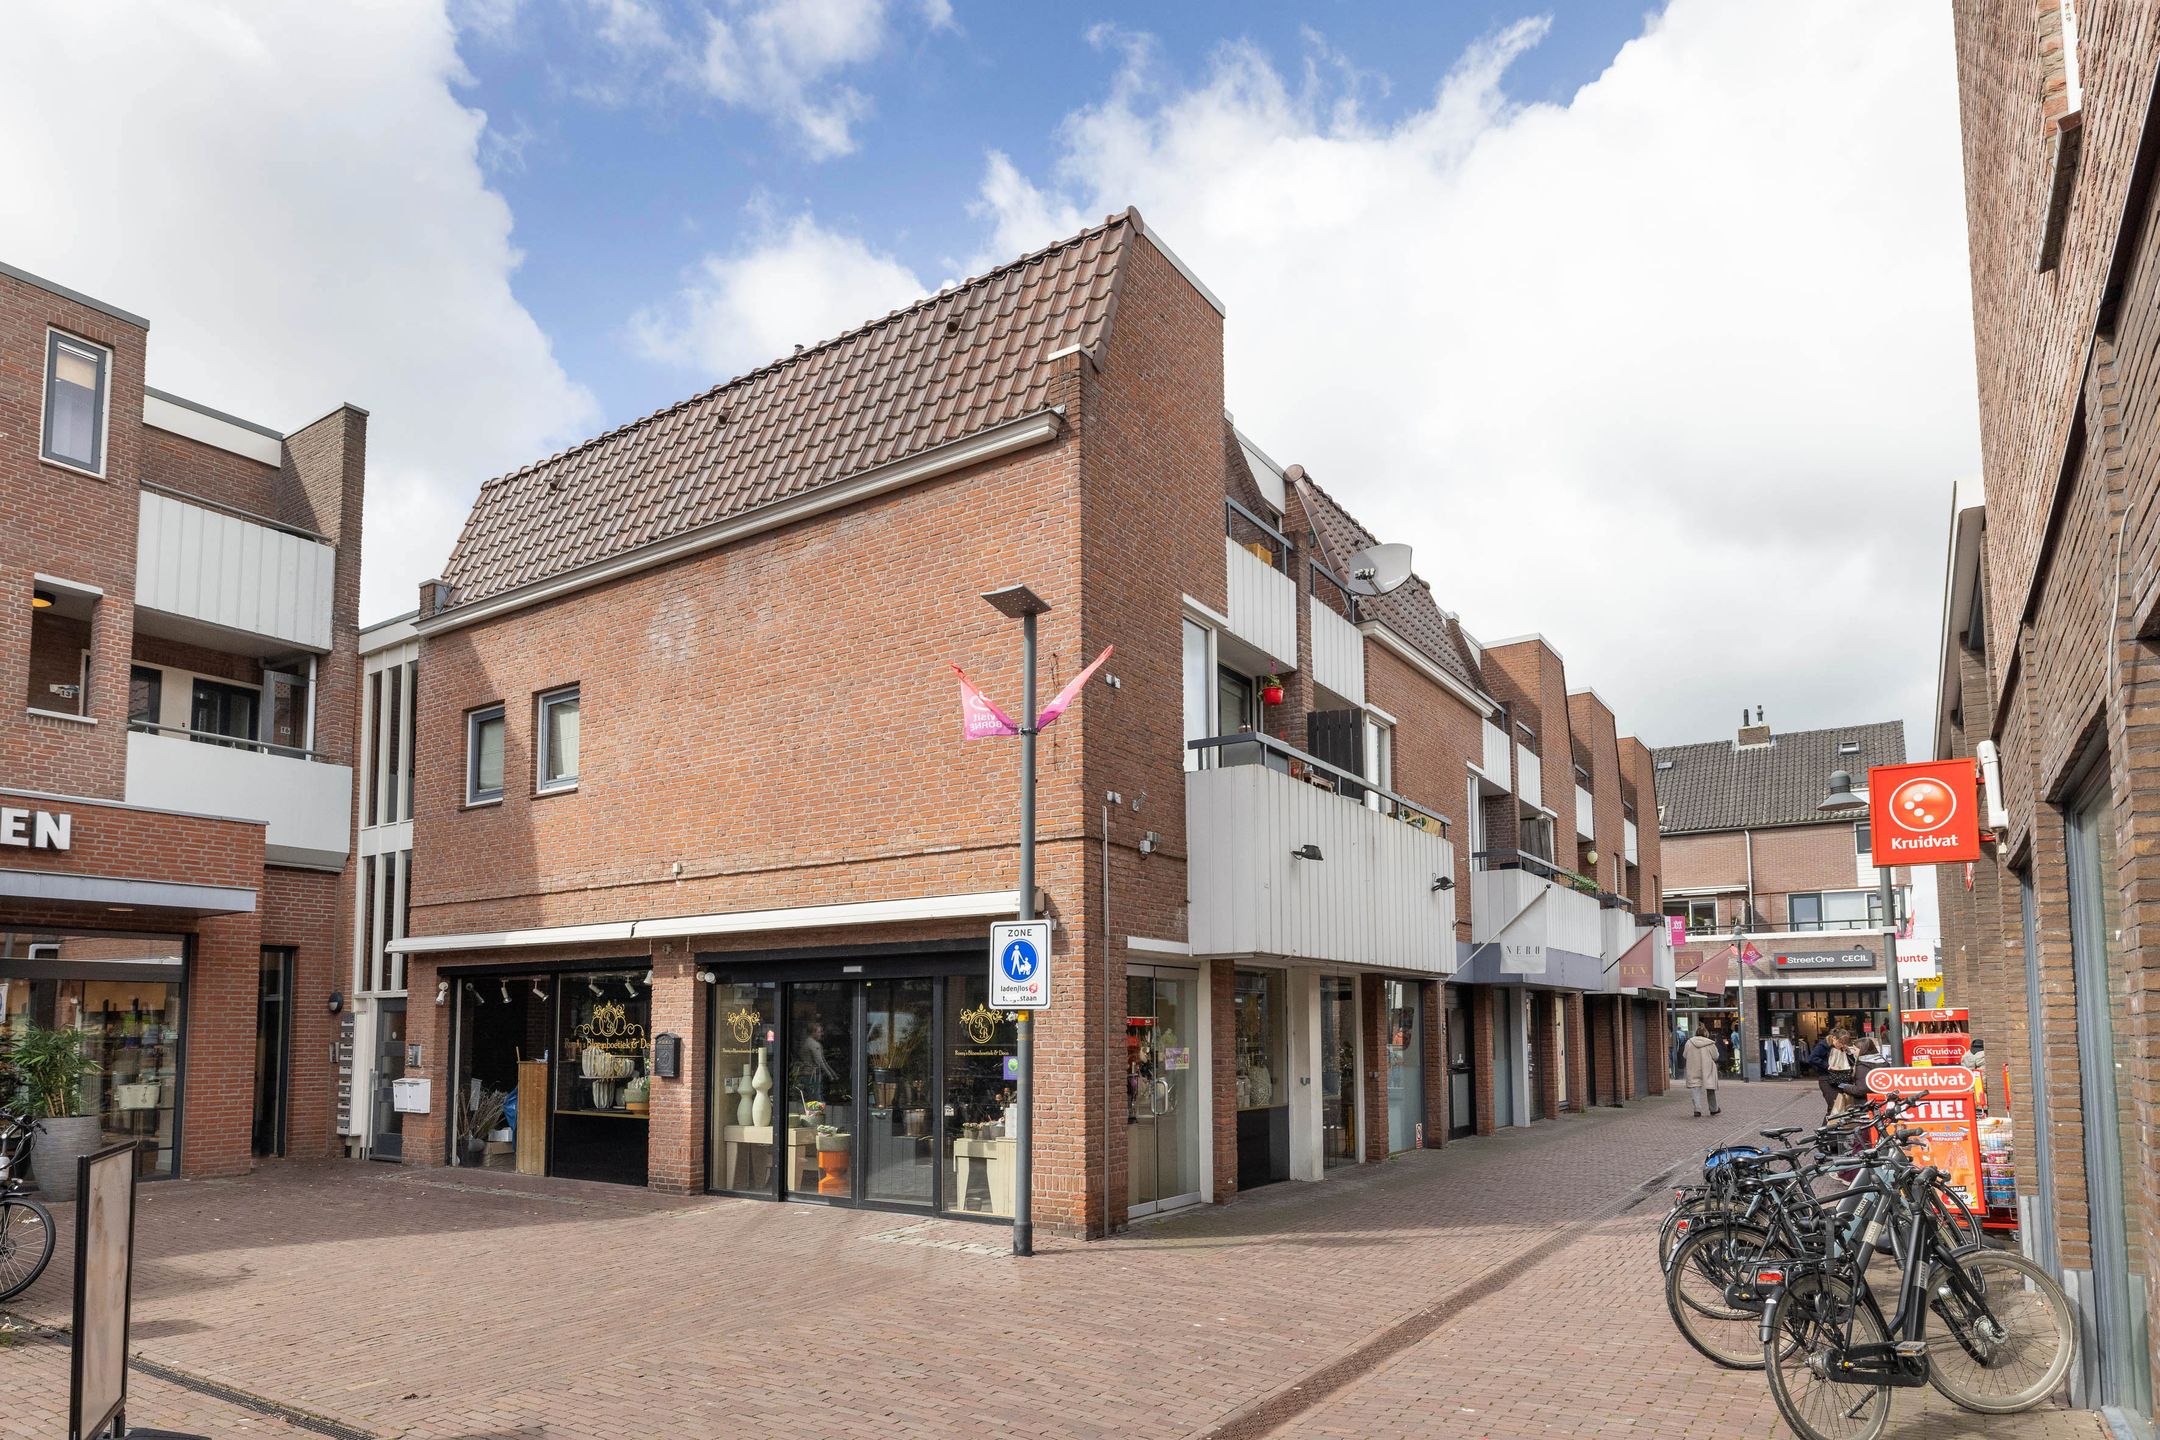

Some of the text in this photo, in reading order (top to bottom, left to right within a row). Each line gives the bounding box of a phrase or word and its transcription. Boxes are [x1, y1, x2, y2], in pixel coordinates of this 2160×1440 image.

[0, 807, 71, 850] EN
[1891, 834, 1959, 850] Kruidvat
[1007, 929, 1032, 937] ZONE
[1787, 954, 1869, 964] Street One CECIL
[1926, 1047, 1962, 1055] Kruidvat
[1893, 1072, 1967, 1087] Kruidvat
